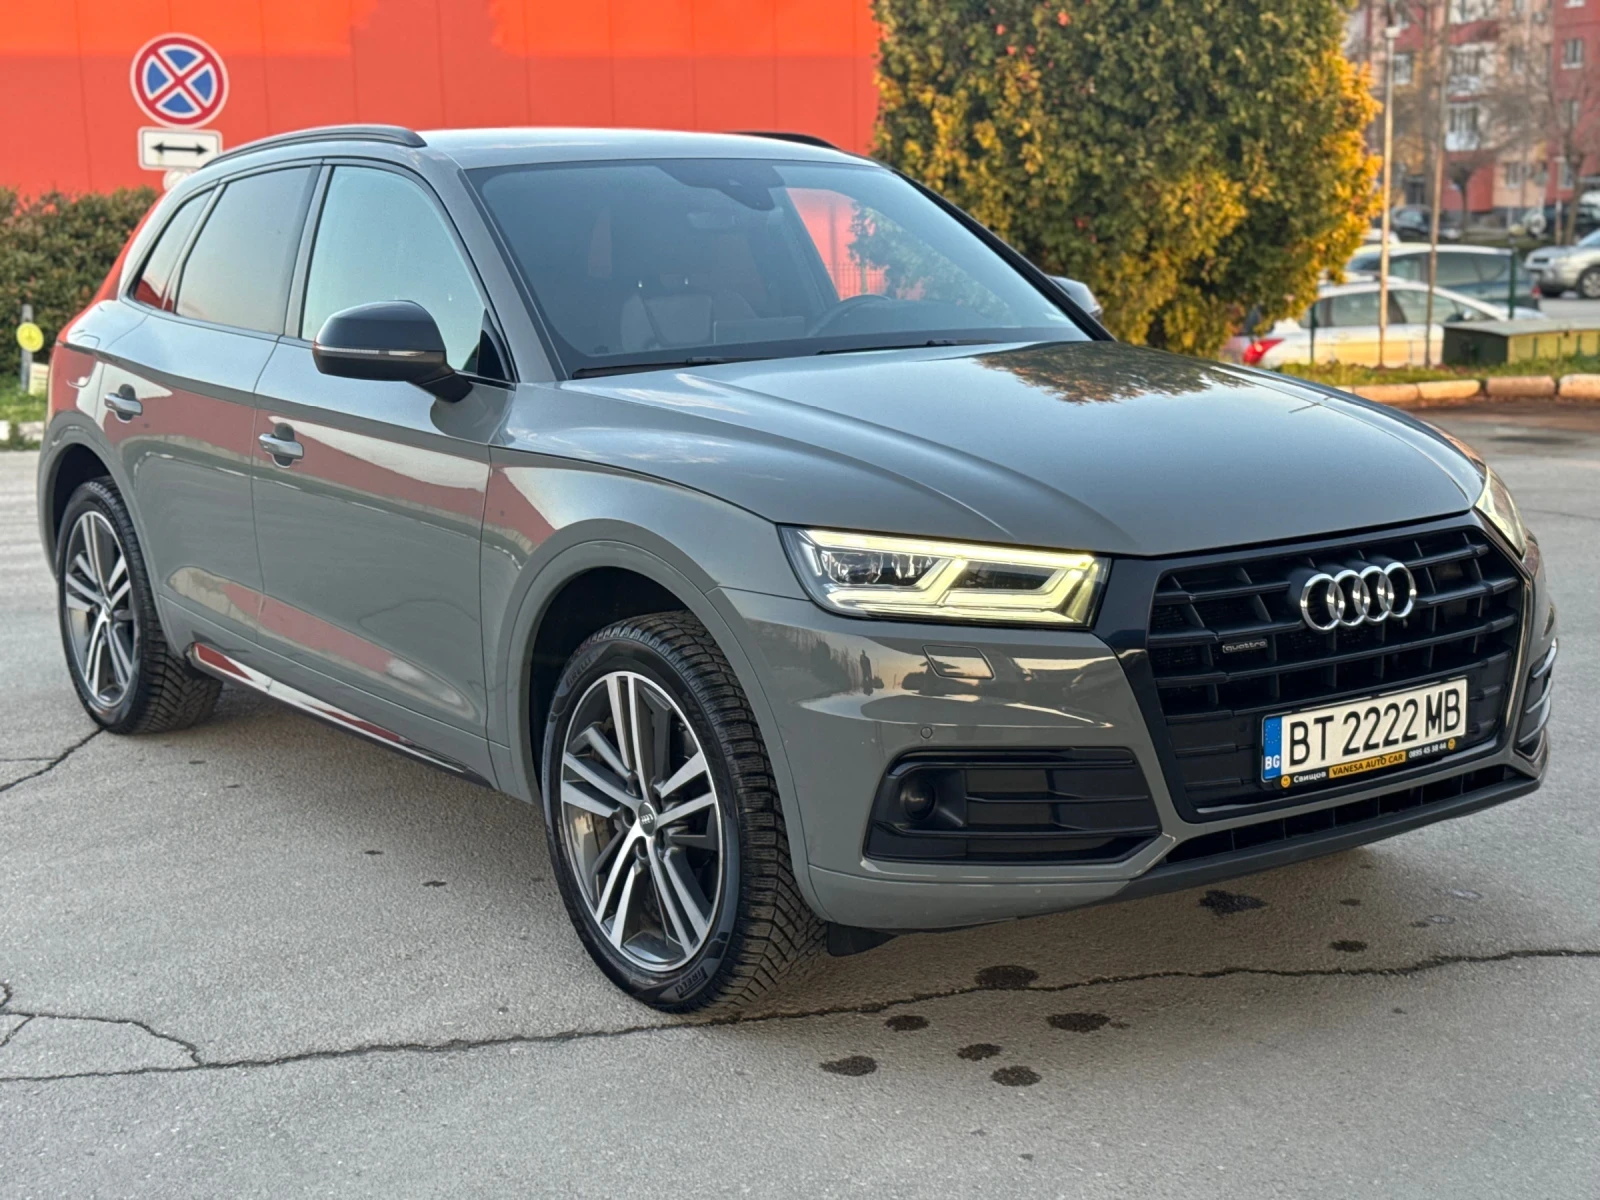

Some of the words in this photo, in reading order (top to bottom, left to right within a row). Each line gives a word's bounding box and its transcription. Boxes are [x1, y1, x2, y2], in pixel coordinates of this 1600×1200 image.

[1225, 641, 1266, 651] quattro
[1289, 715, 1334, 767] BT
[1342, 698, 1419, 757] 2222
[1425, 688, 1461, 738] MB
[1264, 754, 1281, 770] BG
[1332, 762, 1364, 776] VANESA
[1365, 757, 1386, 770] AUTO
[1388, 754, 1403, 764] CAR
[1293, 770, 1327, 783] Свищов
[675, 966, 709, 999] PIRELLI
